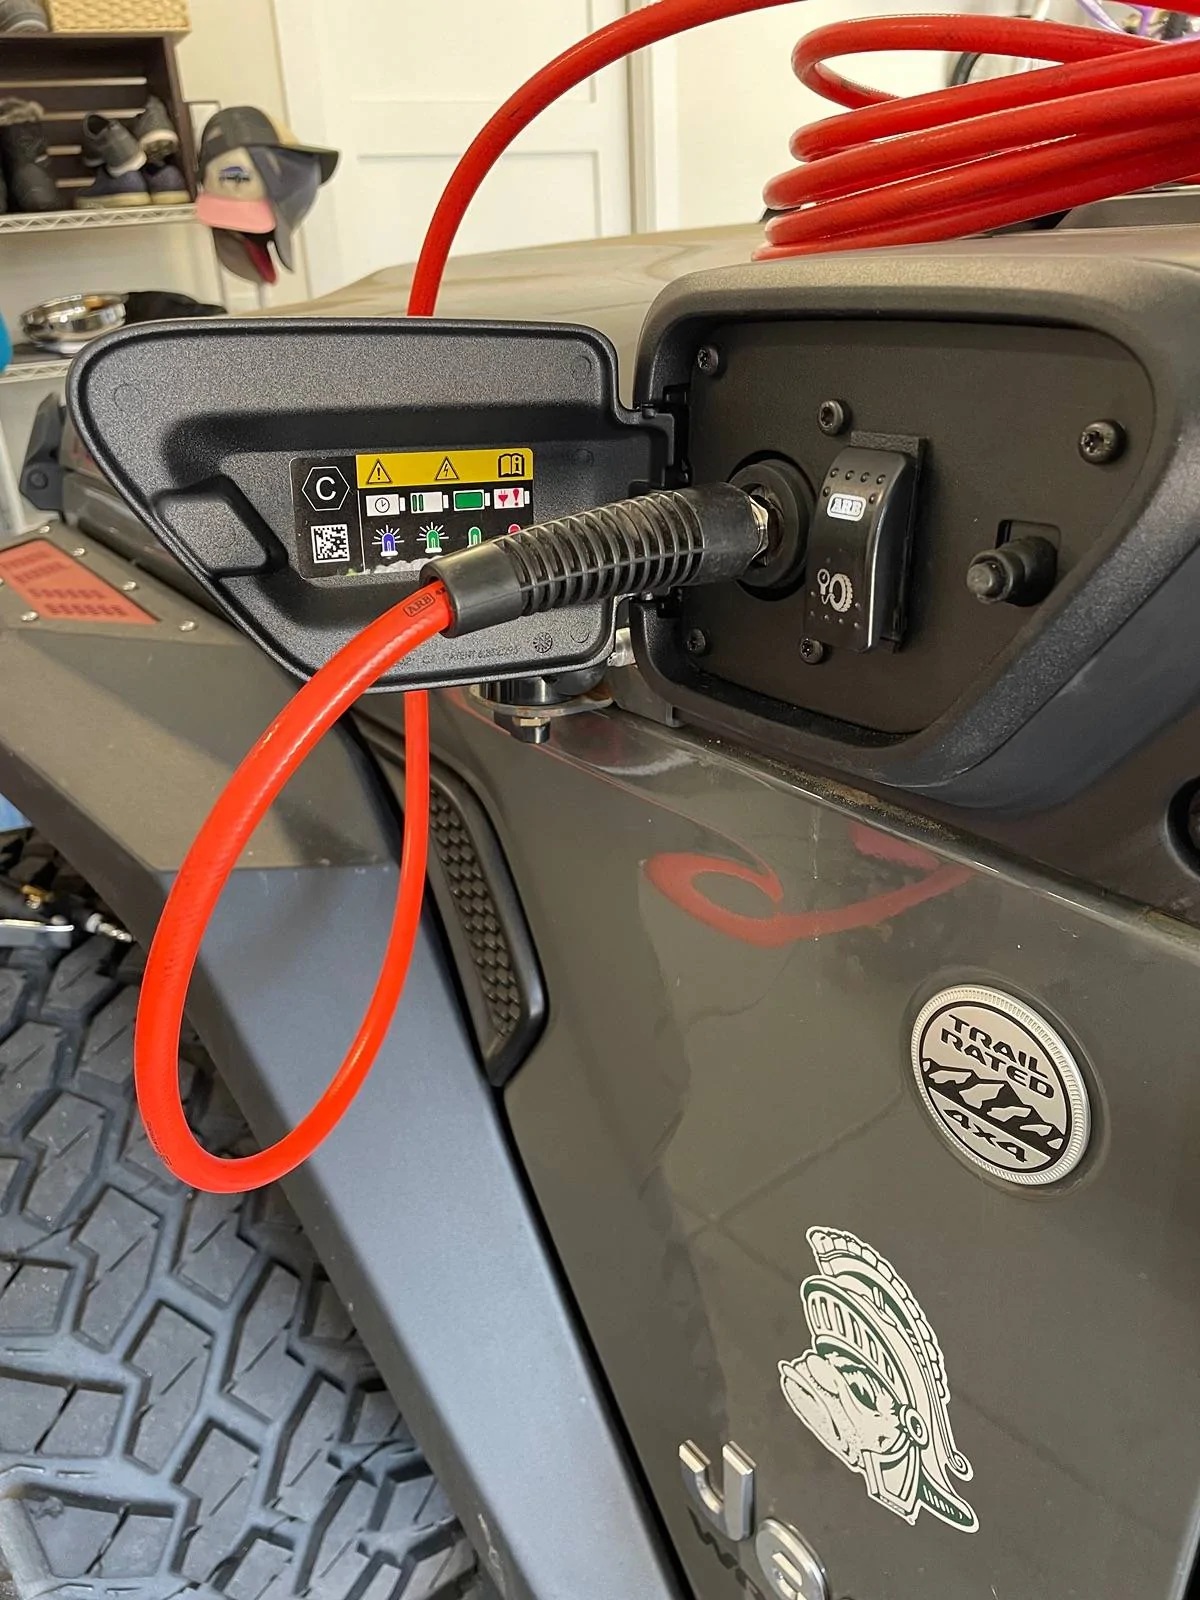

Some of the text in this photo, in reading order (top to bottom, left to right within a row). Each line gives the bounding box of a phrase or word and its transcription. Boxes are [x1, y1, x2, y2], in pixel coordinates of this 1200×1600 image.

[315, 476, 337, 500] C
[830, 497, 863, 517] ARB
[941, 1028, 1054, 1099] RATED
[949, 1014, 1048, 1080] TRAIL
